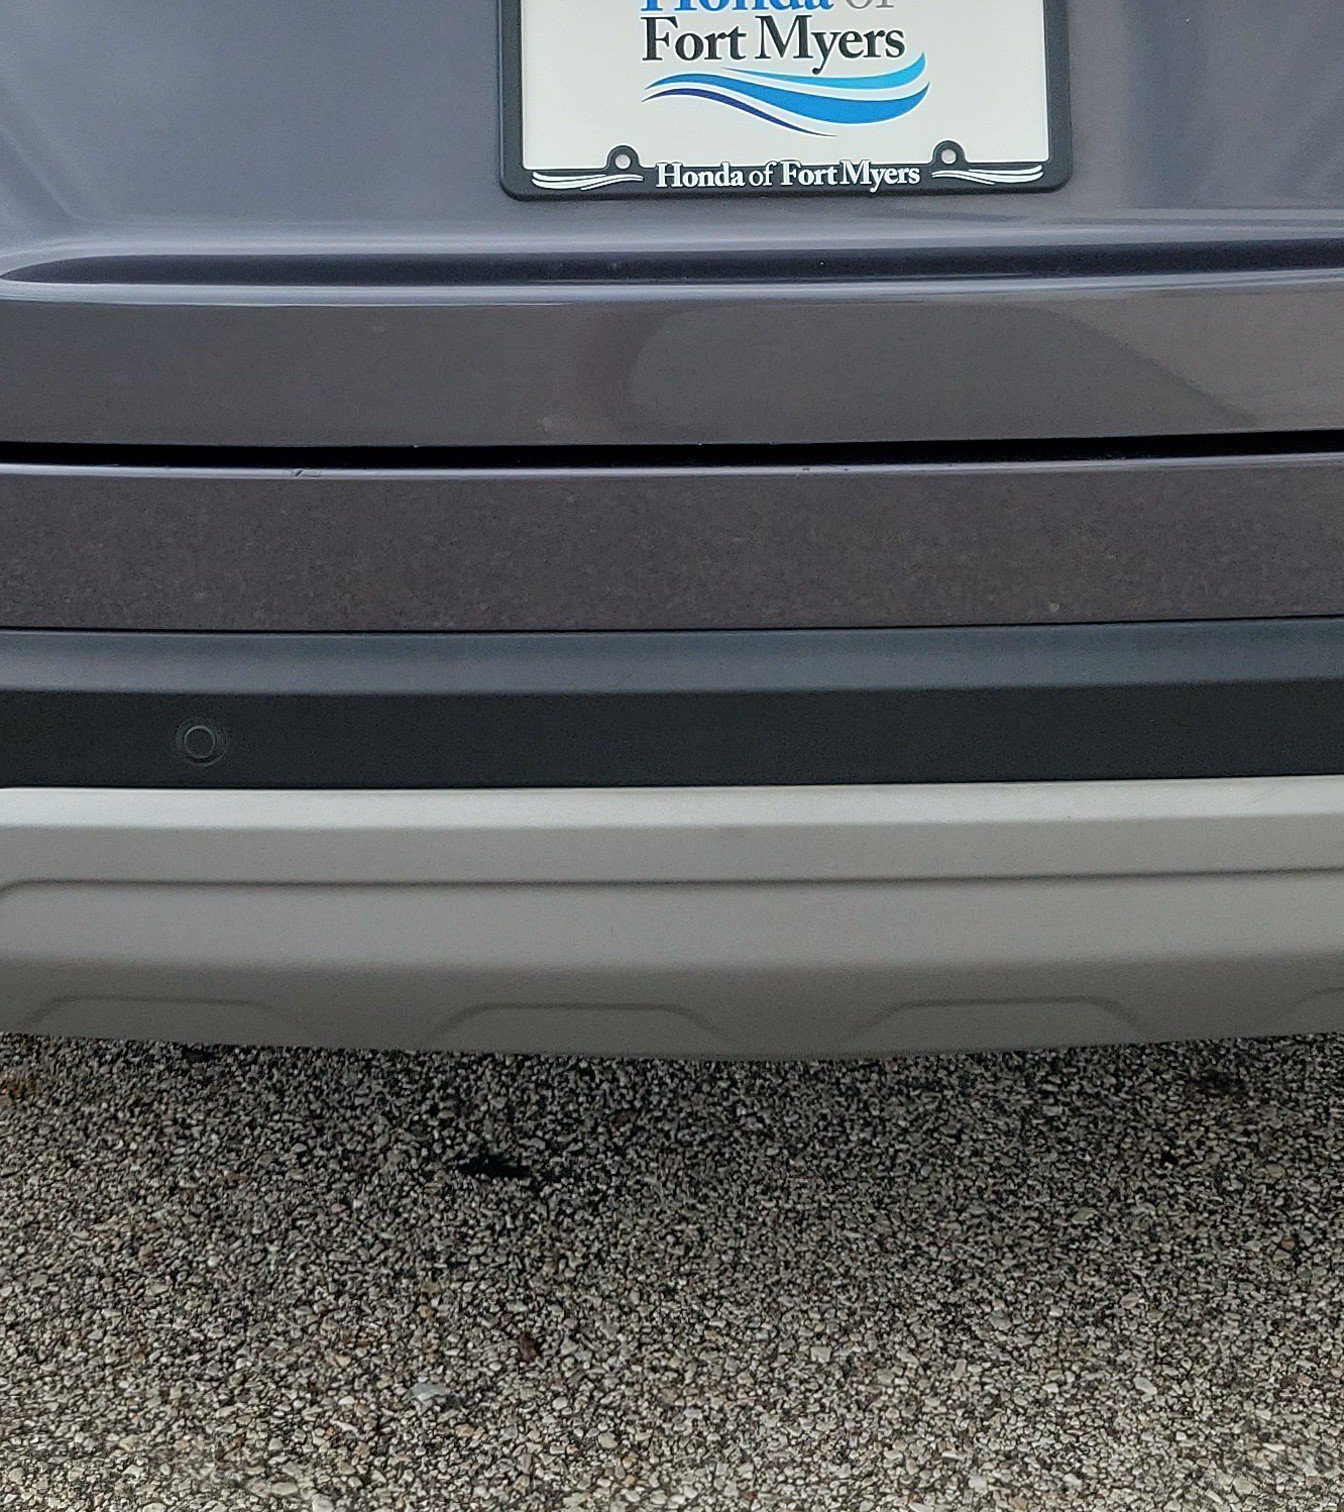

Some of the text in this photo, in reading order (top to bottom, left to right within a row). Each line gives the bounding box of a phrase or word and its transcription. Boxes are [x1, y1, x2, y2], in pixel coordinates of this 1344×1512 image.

[642, 14, 906, 74] Fort Myers
[656, 162, 921, 192] Honda of Fort Myers
